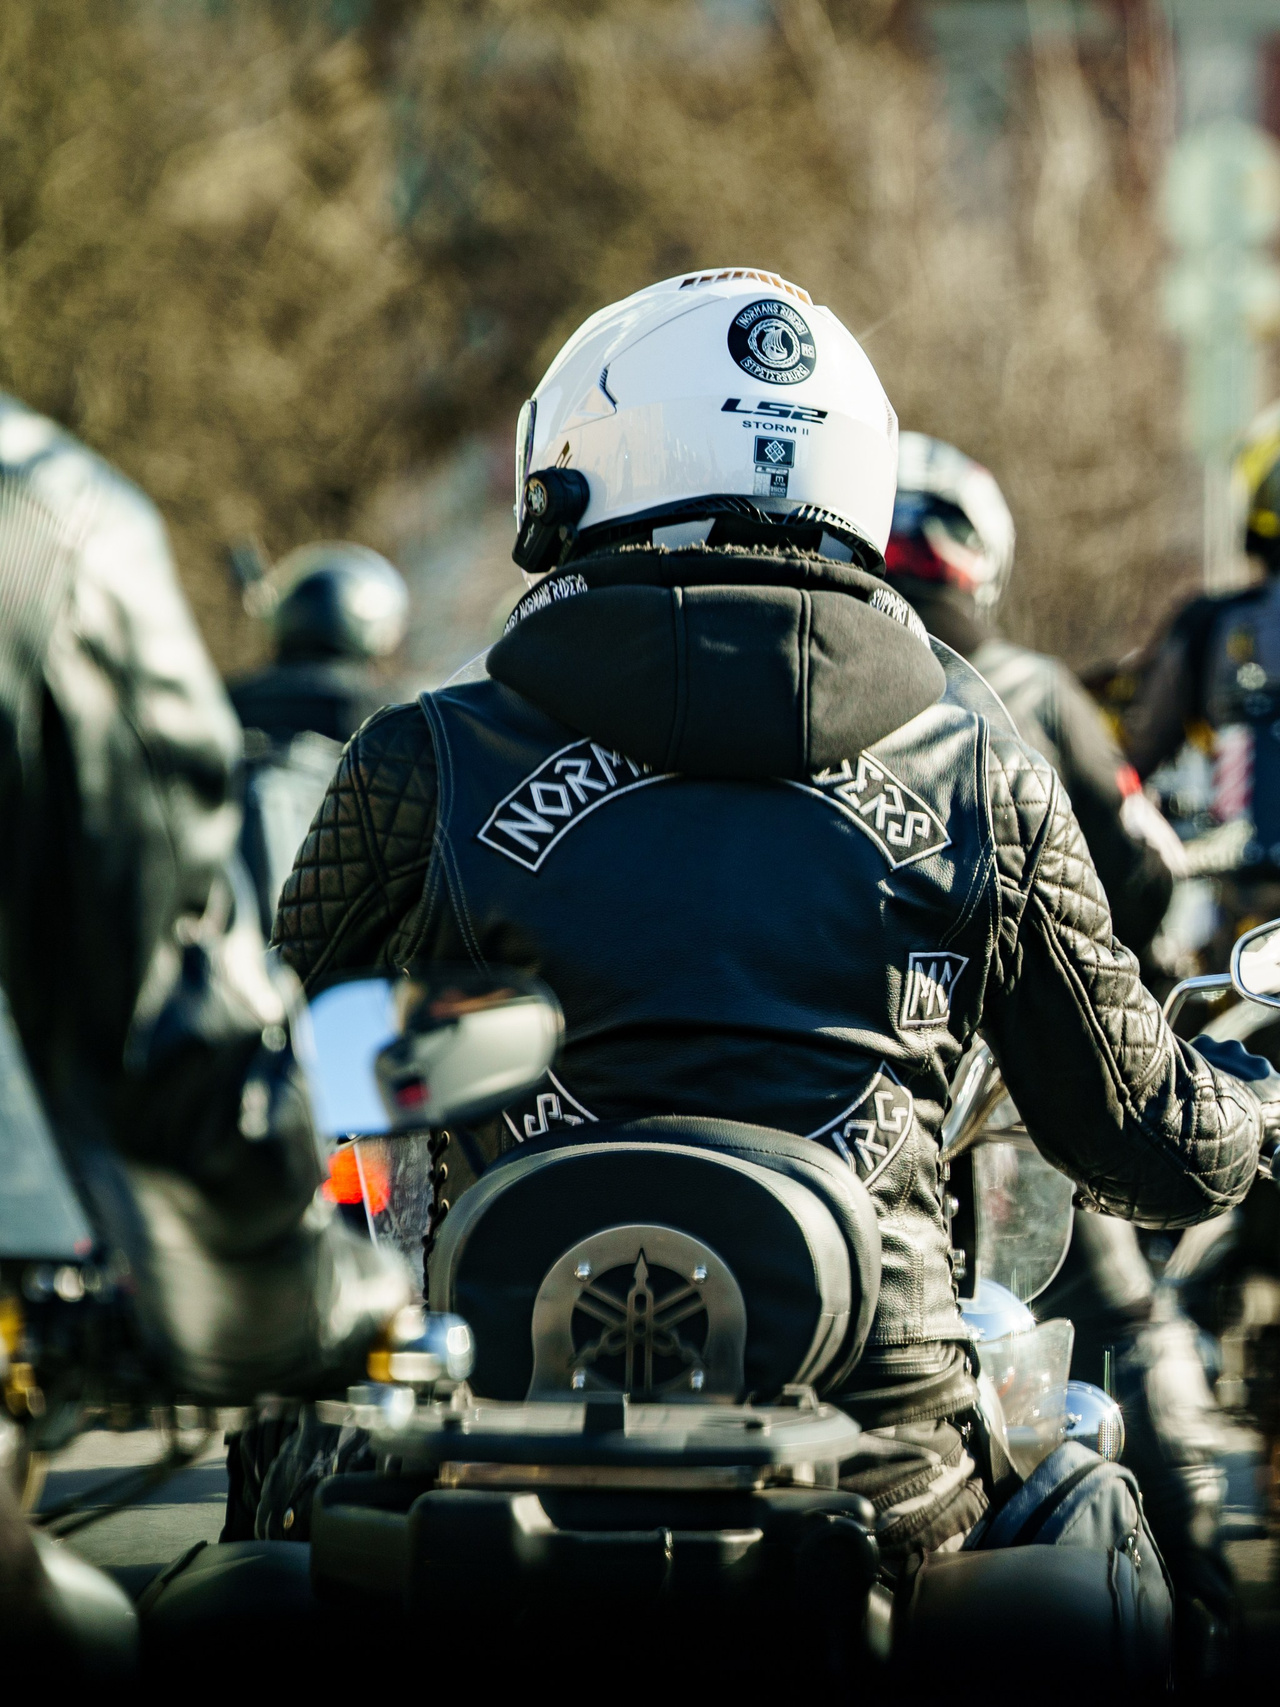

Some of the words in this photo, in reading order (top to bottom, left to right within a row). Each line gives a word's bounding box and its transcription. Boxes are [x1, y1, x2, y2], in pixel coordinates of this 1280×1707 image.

[739, 302, 780, 327] NORMANS
[720, 397, 828, 425] LS2
[742, 420, 797, 434] STORM
[494, 742, 653, 853] NORM
